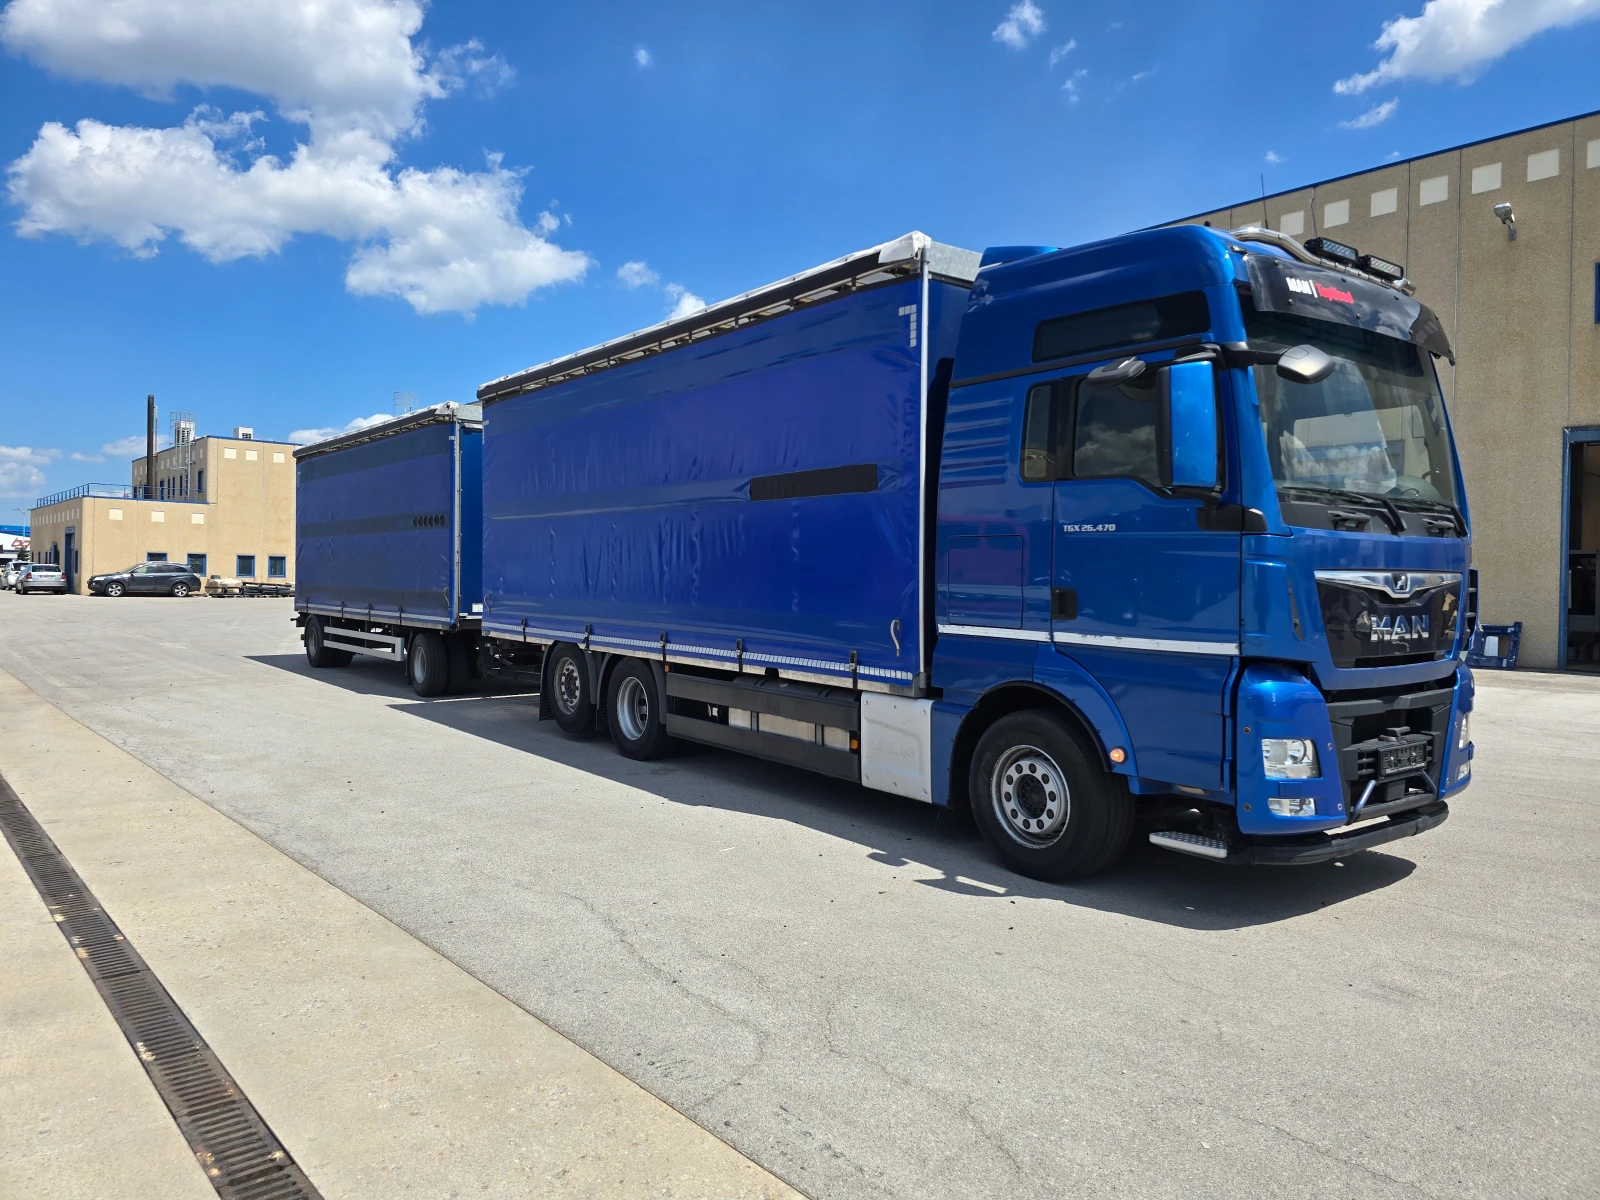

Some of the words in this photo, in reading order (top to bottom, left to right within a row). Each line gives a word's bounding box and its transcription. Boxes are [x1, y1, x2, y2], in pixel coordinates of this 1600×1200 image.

[1063, 524, 1080, 532] TGX
[1081, 523, 1116, 532] 26.470
[1370, 614, 1429, 642] MAN
